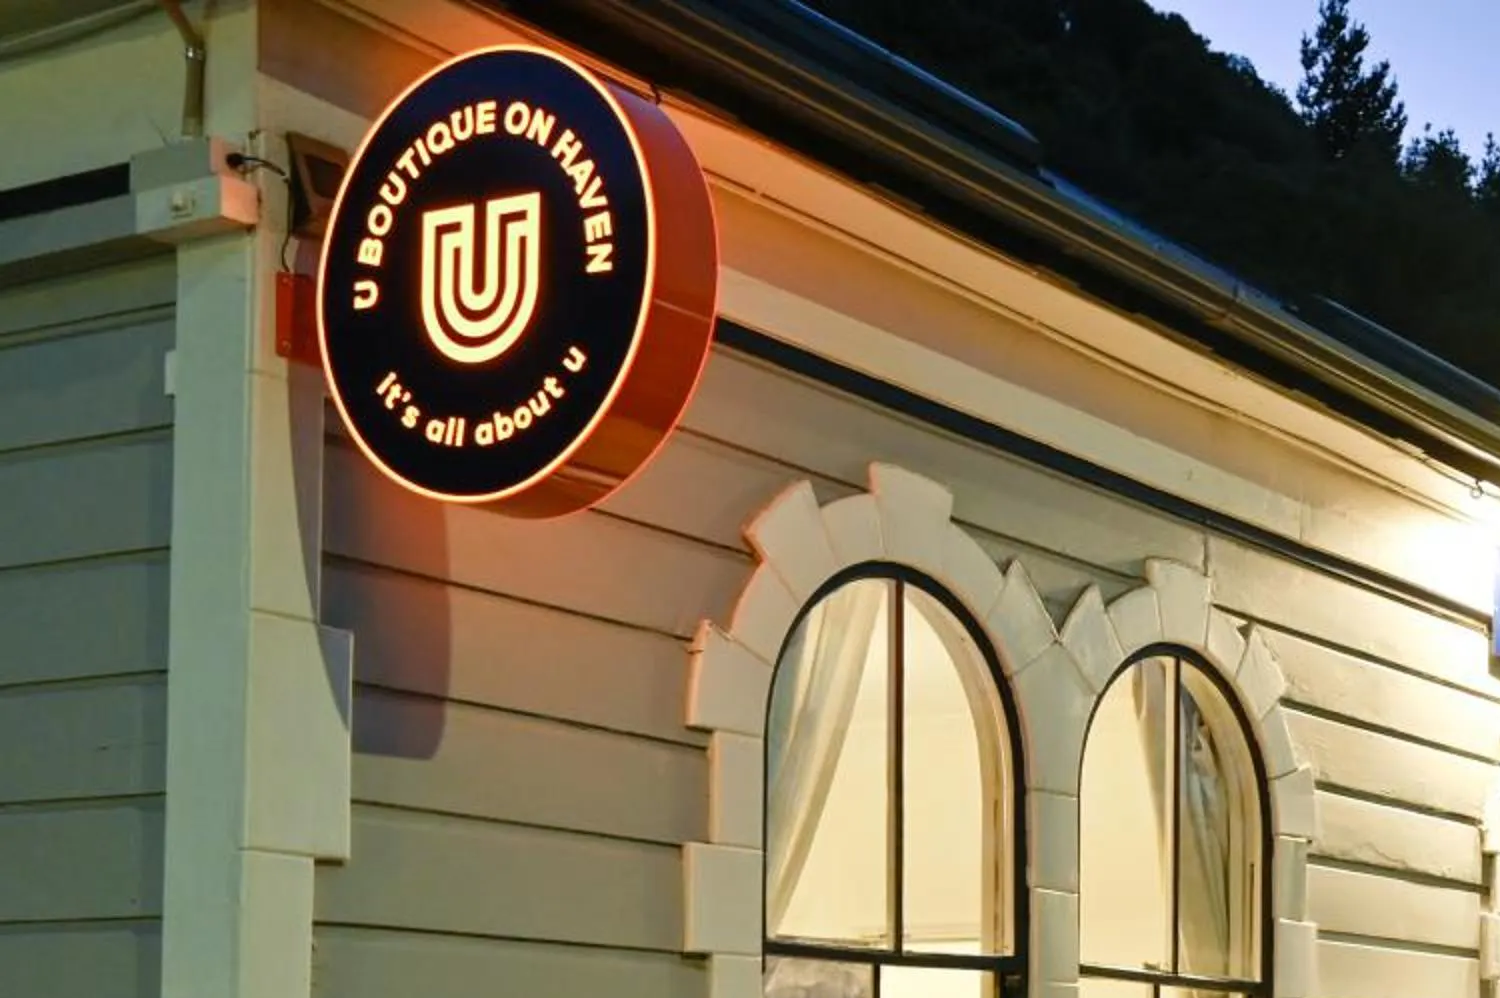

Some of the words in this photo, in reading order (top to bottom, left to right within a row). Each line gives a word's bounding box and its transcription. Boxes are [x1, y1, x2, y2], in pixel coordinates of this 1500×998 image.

[357, 101, 497, 267] BOUTIQUE
[504, 101, 556, 147] ON
[551, 128, 613, 274] HAVEN
[353, 279, 379, 309] U
[421, 191, 541, 363] U
[425, 417, 465, 447] all
[474, 377, 566, 446] about
[562, 346, 587, 373] u
